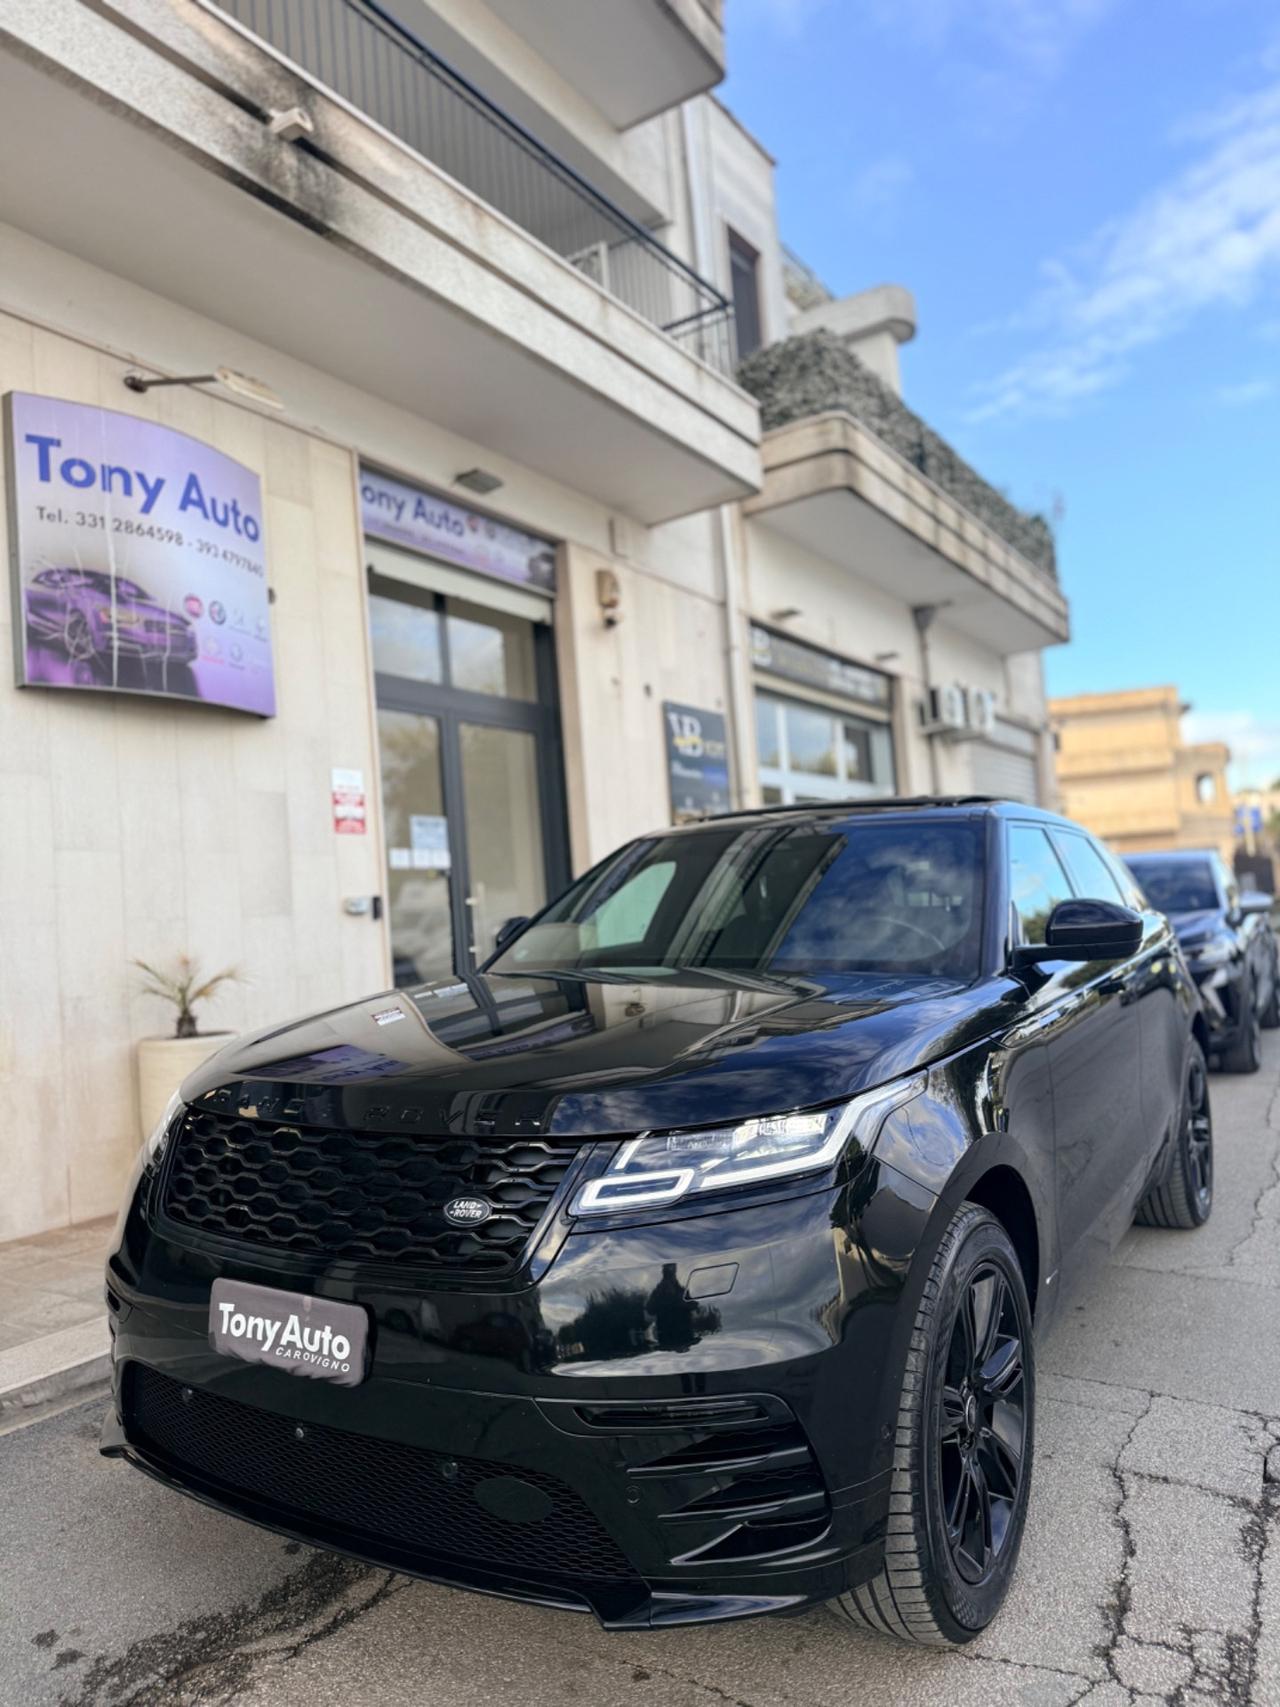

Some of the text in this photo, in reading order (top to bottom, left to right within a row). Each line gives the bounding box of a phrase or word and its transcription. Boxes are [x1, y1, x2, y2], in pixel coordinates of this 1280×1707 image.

[24, 433, 260, 542] Tony Auto
[360, 484, 465, 538] ony Auto
[36, 505, 69, 525] Tel.
[75, 511, 106, 530] 331
[112, 517, 184, 547] 2864598
[275, 1346, 351, 1373] CAROVIGNO
